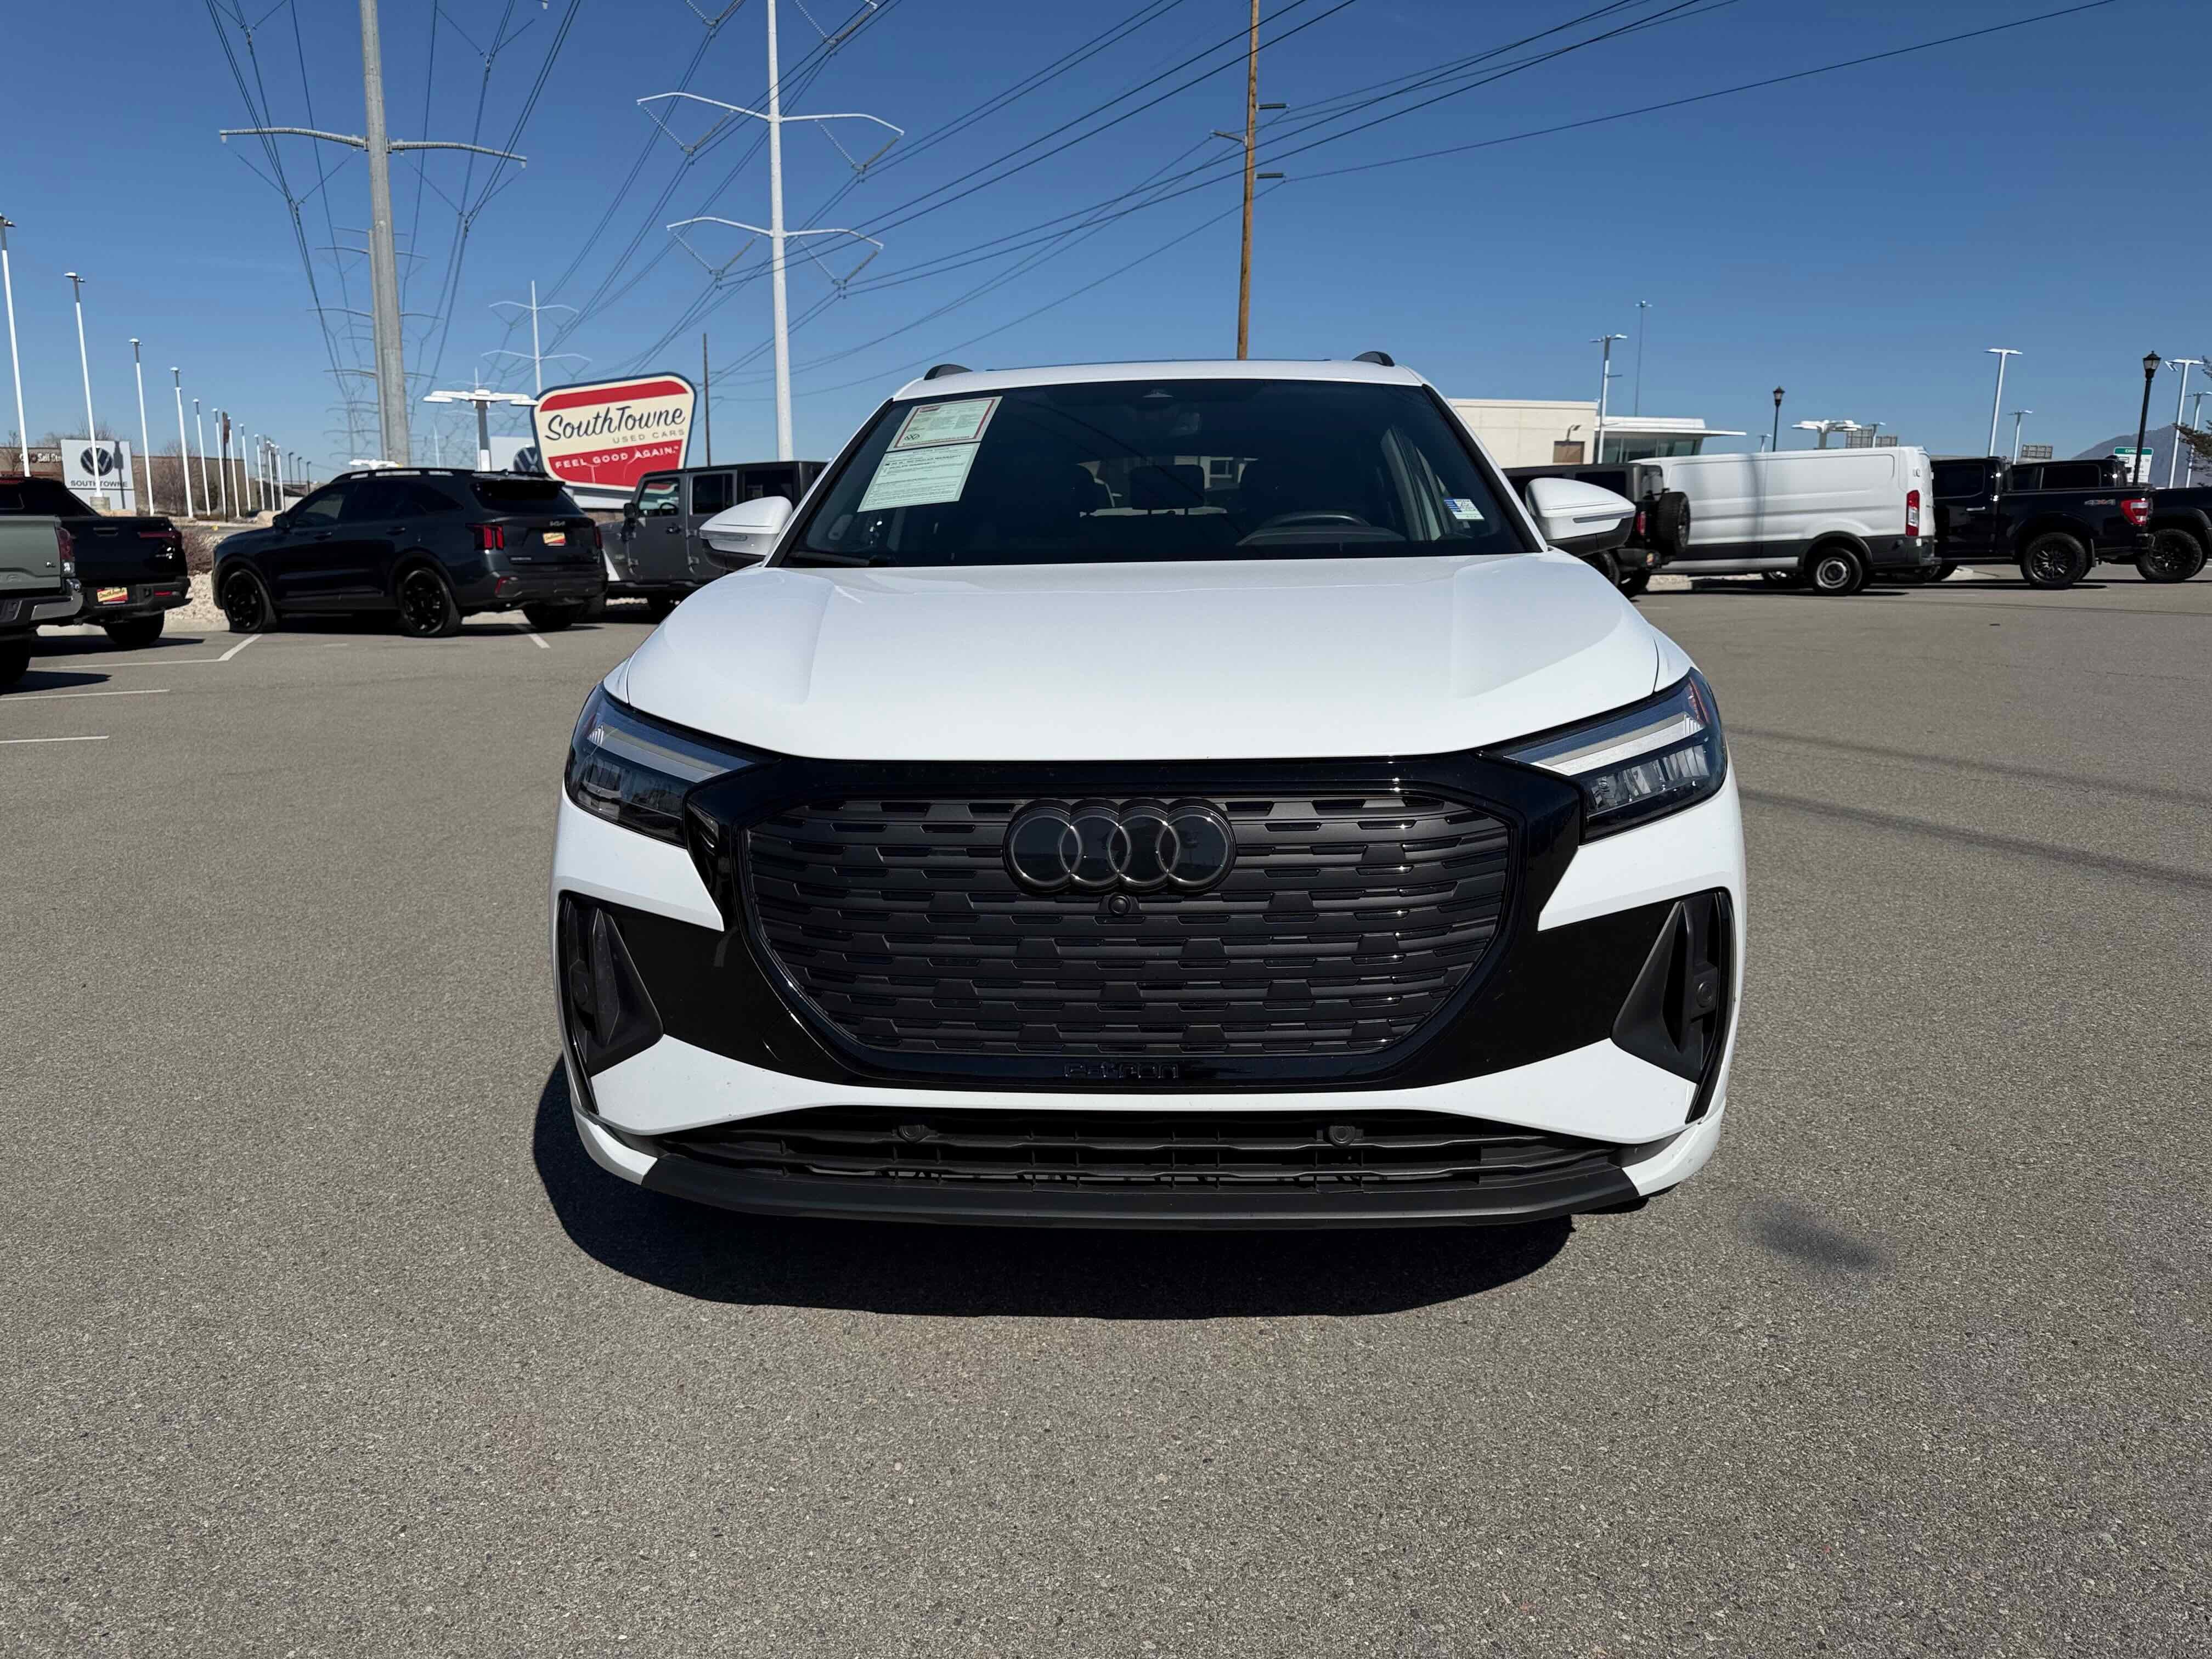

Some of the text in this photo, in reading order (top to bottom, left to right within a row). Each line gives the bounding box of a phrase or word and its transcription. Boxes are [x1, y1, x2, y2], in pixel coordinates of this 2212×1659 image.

[545, 406, 686, 441] SouthTowne
[613, 429, 685, 444] USED CARS
[555, 456, 588, 469] FEEL
[592, 452, 628, 464] GOOD
